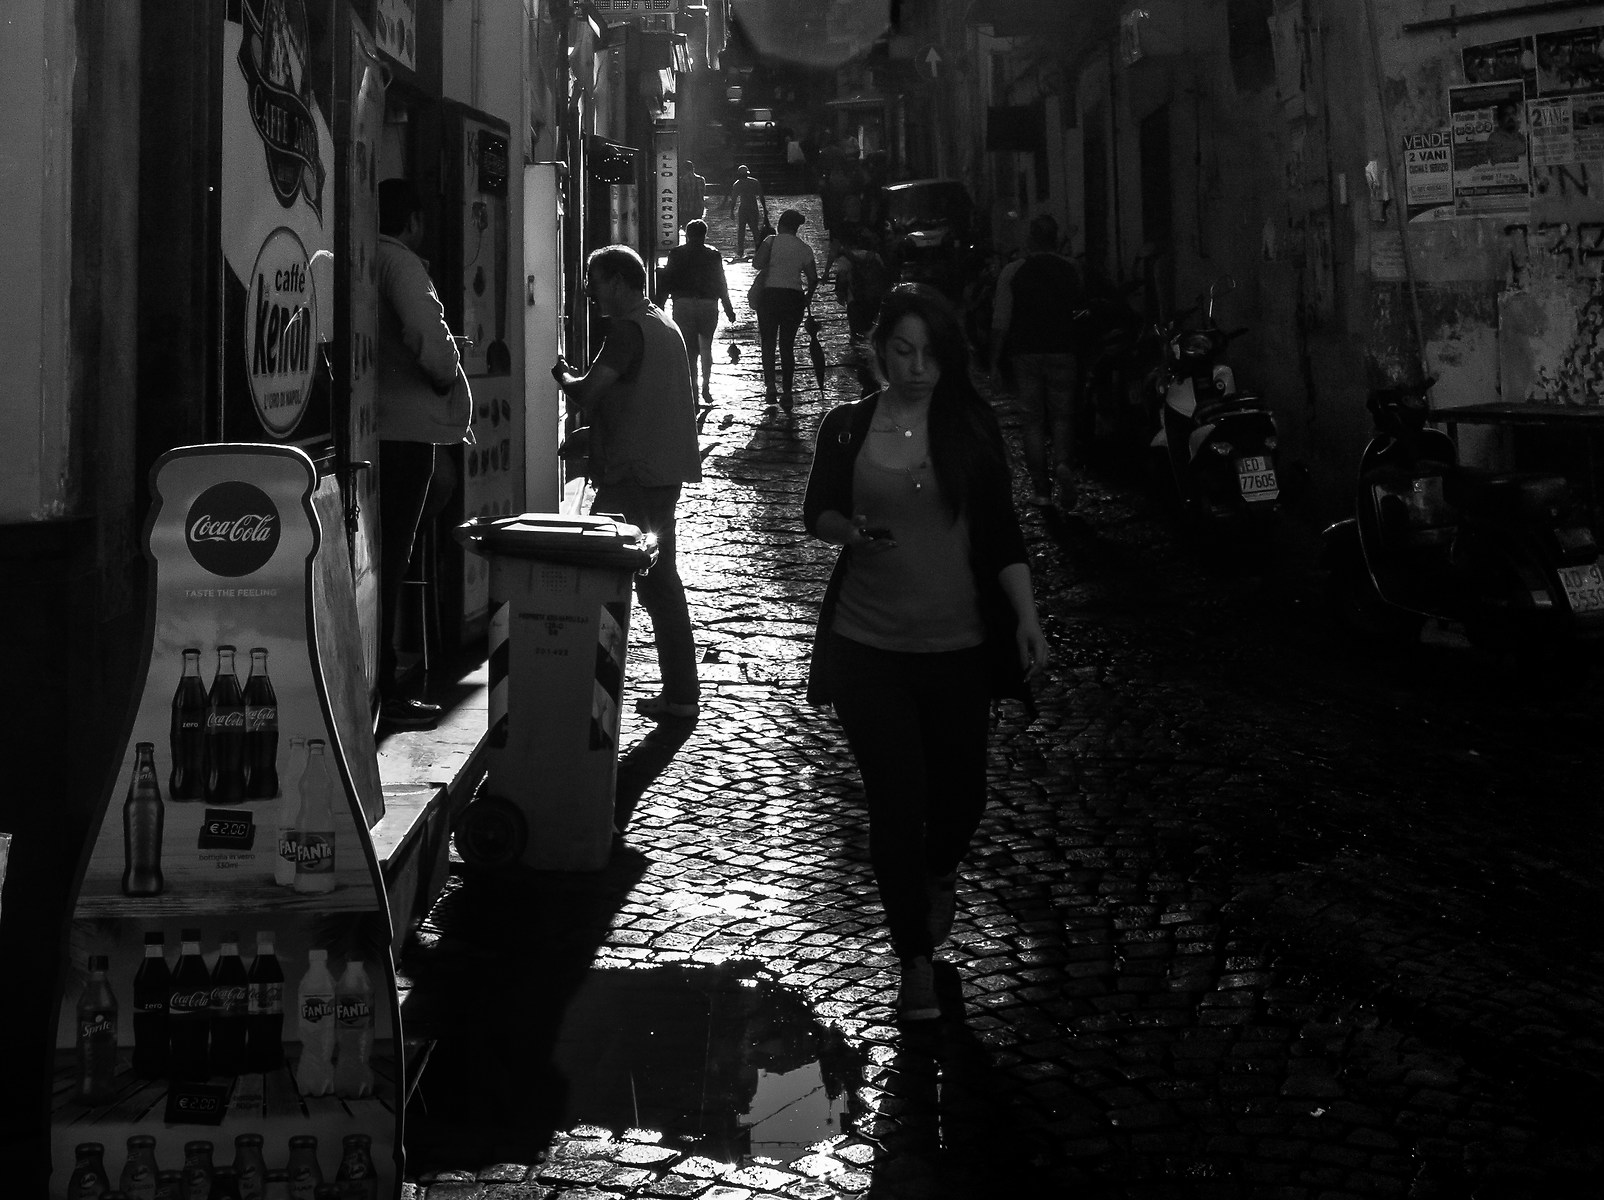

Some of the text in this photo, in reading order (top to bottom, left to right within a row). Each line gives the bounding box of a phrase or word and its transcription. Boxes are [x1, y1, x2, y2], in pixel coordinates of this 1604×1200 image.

[1403, 133, 1450, 150] VENDE
[1409, 150, 1447, 162] 2 VANI
[660, 188, 674, 246] ARROSTO
[253, 273, 311, 376] kenon
[1241, 473, 1275, 490] 77605
[190, 514, 276, 542] Coca-Cola
[185, 588, 277, 598] TASTE THE FEELING
[199, 853, 228, 863] bottiglia
[238, 853, 256, 861] vetro
[297, 843, 333, 862] FANTA
[303, 1003, 335, 1018] FANTA
[337, 1003, 370, 1019] FANTA
[82, 1020, 112, 1038] Sprite
